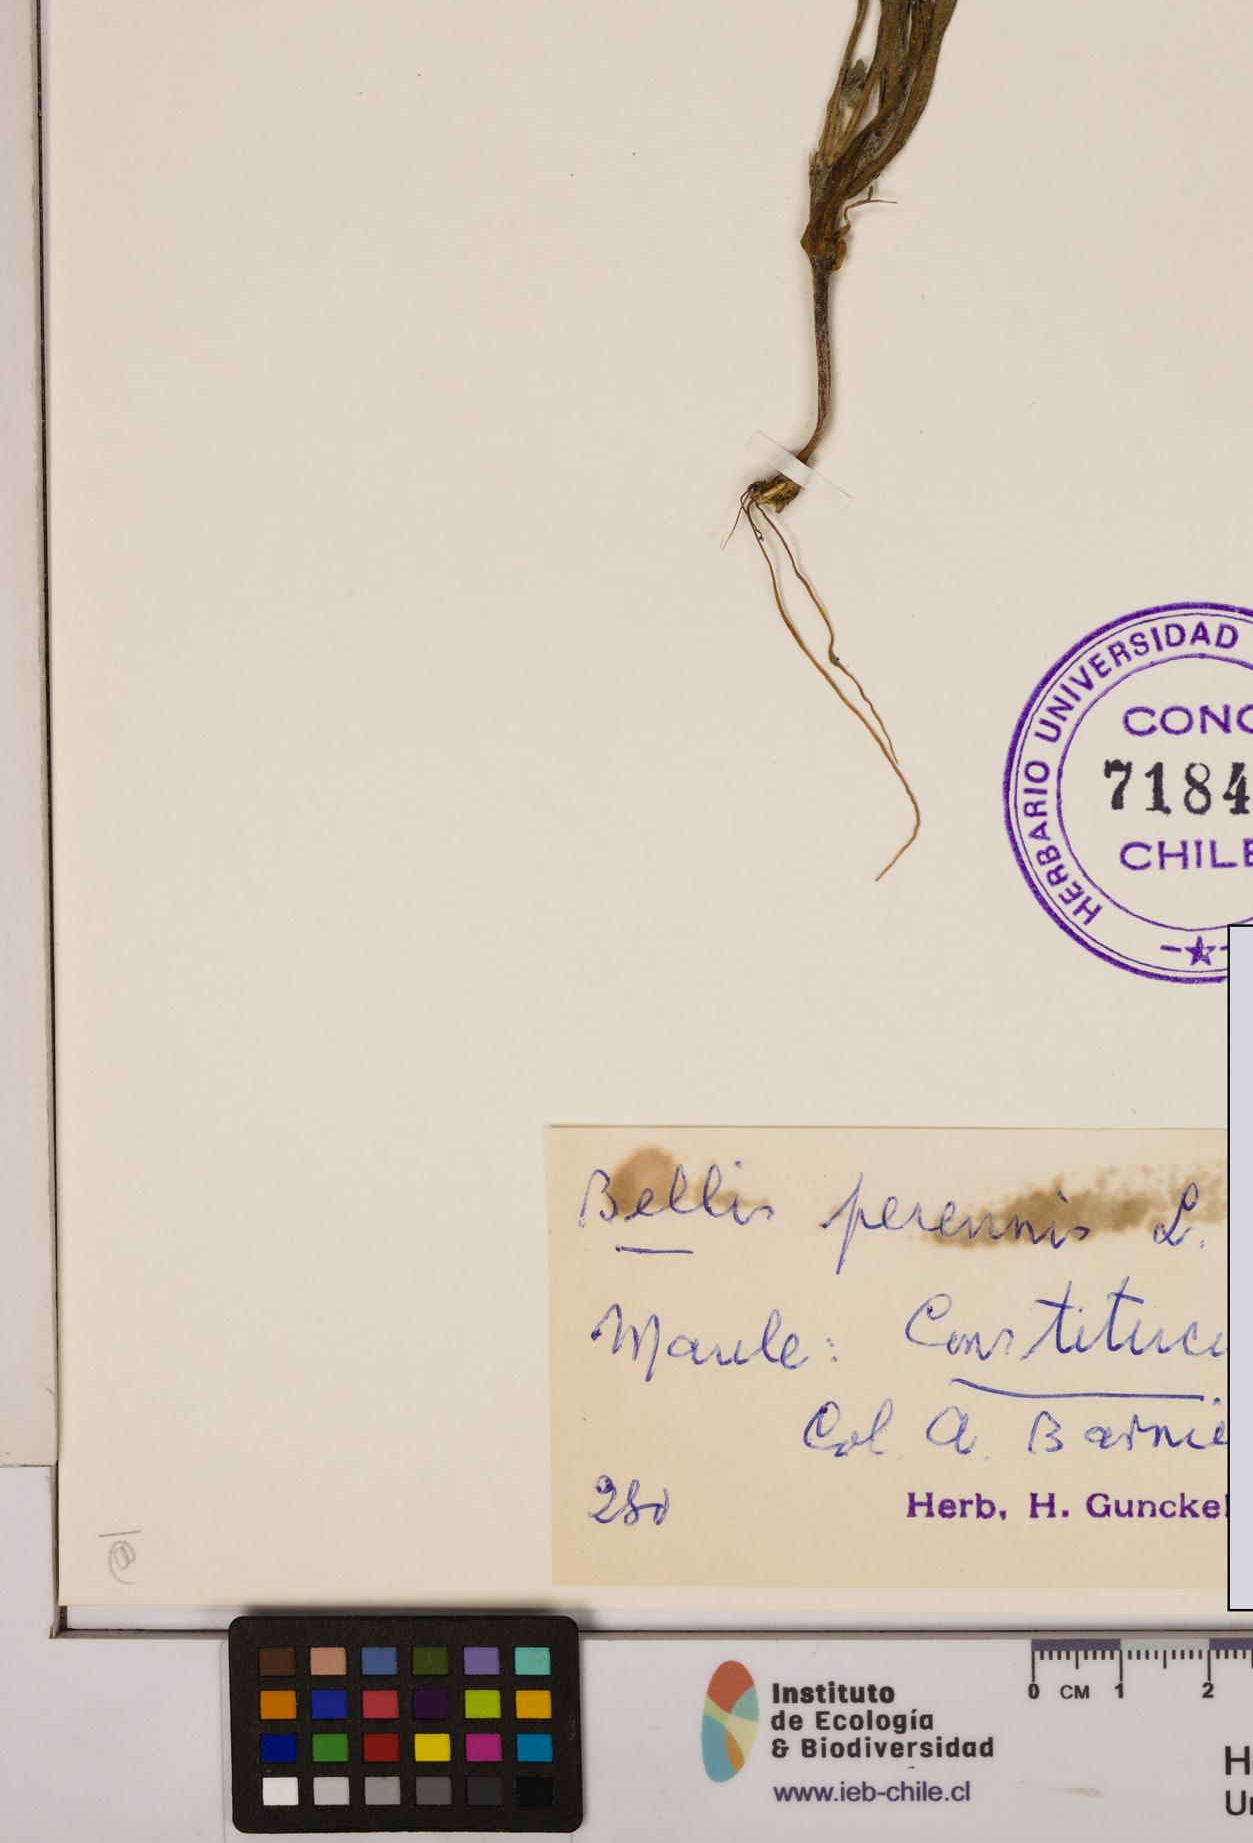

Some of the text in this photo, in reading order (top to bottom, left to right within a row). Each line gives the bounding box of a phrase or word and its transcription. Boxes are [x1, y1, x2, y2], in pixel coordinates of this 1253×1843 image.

[1035, 620, 1240, 744] UNIVERSIDAD
[1022, 759, 1102, 926] HERBARIO
[580, 1160, 775, 1227] Bellis
[817, 1171, 1090, 1275] perennis
[906, 1492, 1007, 1520] Herb.
[1029, 1492, 1070, 1519] H.
[771, 1680, 896, 1705] Instituto
[1028, 1683, 1040, 1700] 0
[1059, 1684, 1090, 1700] CM
[1113, 1682, 1125, 1699] 1
[1201, 1681, 1214, 1699] 2
[770, 1709, 934, 1735] de Ecología
[771, 1736, 995, 1759] & Biodiversidad
[773, 1779, 972, 1803] www.ieb-chile.cl
